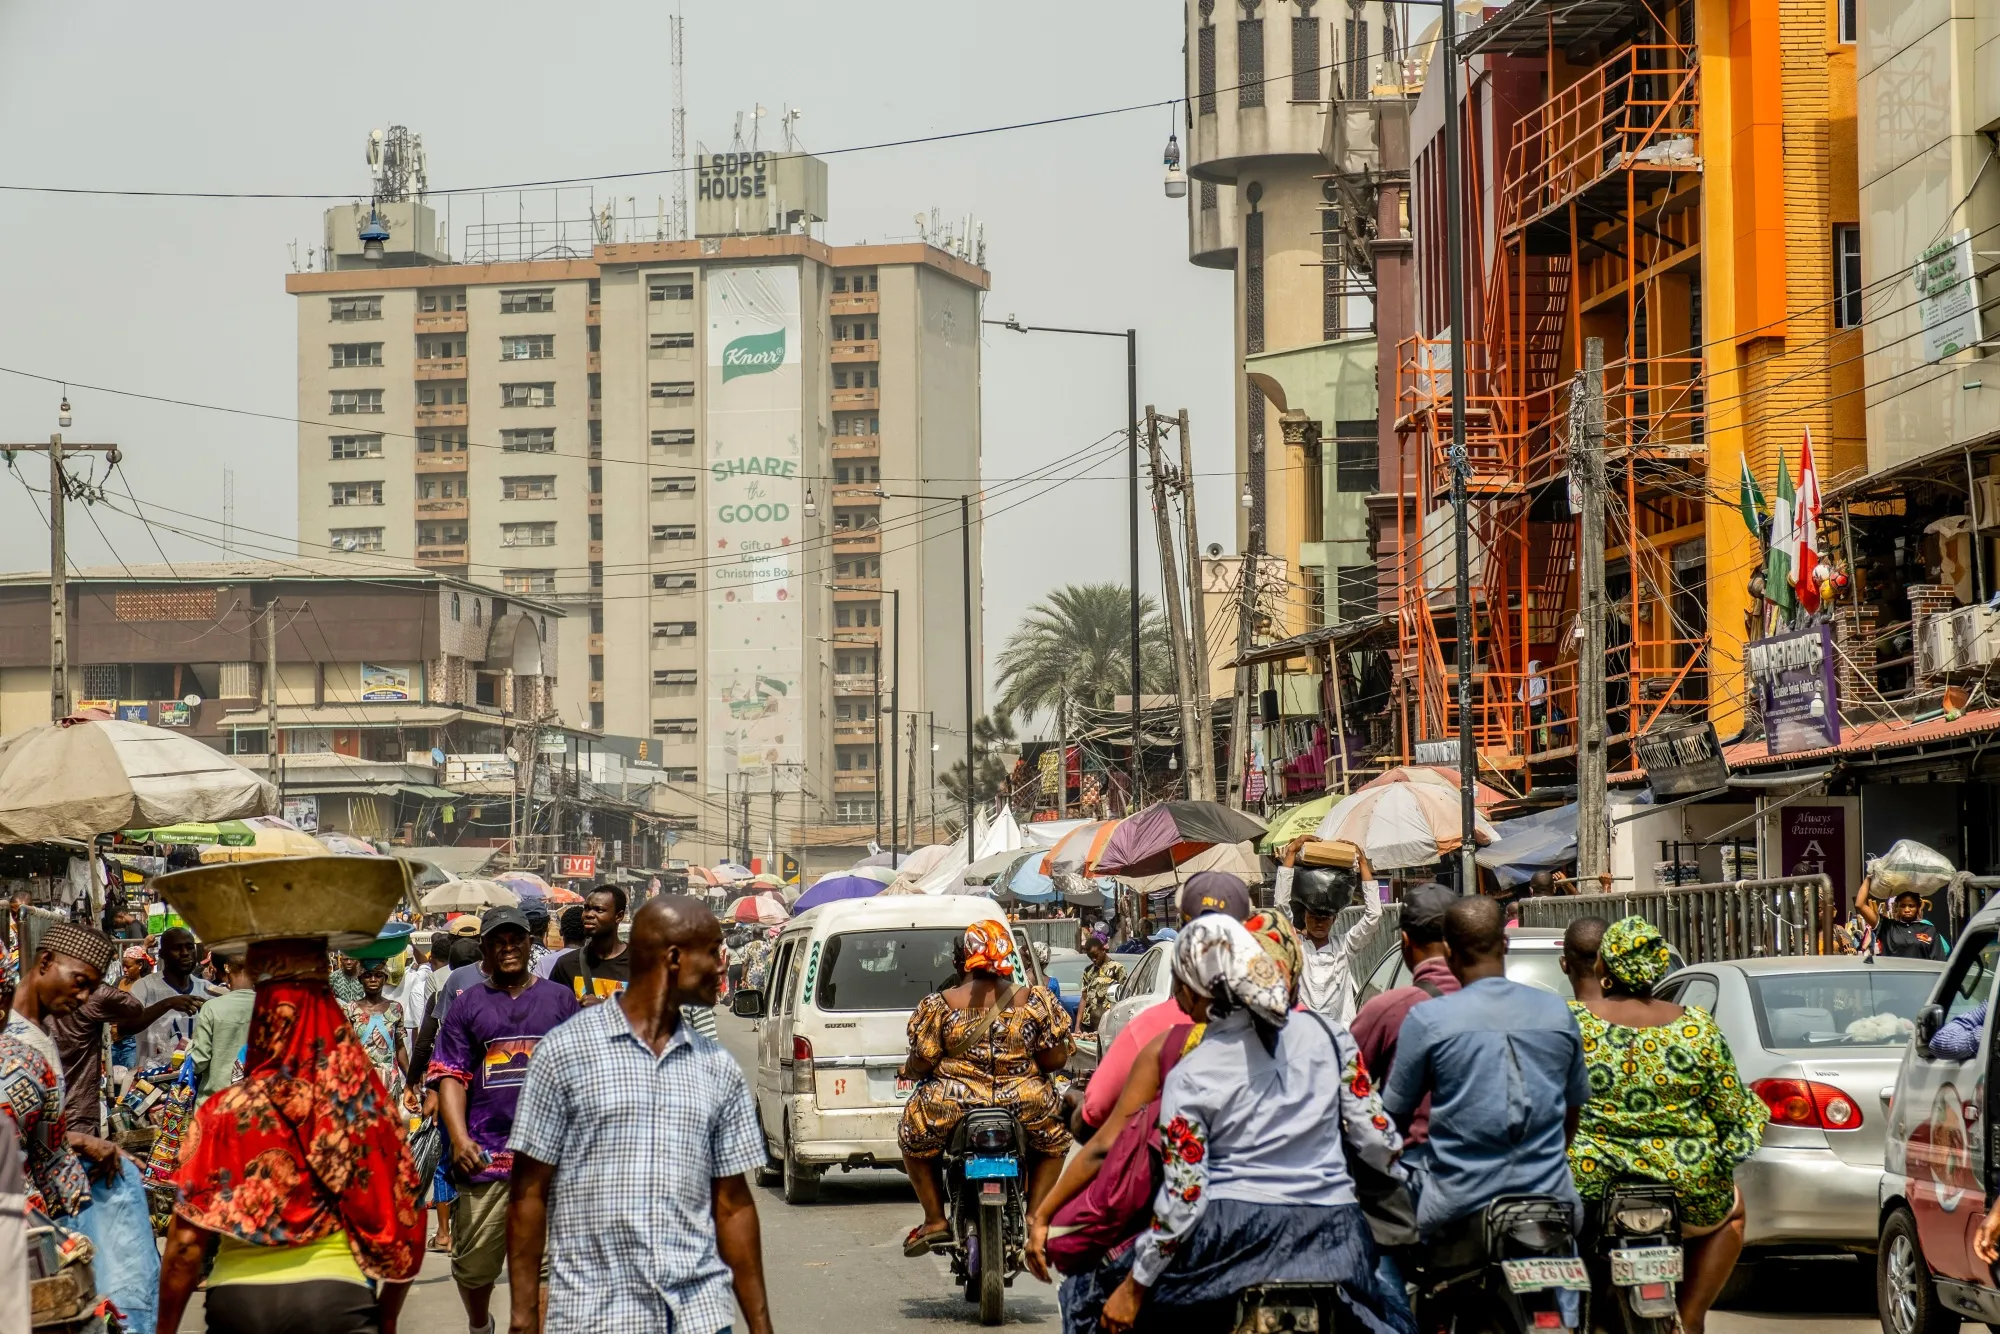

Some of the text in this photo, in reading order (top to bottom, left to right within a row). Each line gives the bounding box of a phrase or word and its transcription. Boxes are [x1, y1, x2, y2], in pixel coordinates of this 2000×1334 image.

[698, 151, 766, 177] LSDPC
[698, 175, 767, 200] HOUSE
[711, 456, 797, 482] SHARE
[743, 480, 767, 500] the
[718, 503, 790, 524] GOOD
[740, 540, 771, 551] Gift a
[741, 553, 769, 563] Knorr
[715, 567, 794, 579] Christmas Box
[1672, 732, 1711, 766] FABRICS
[1795, 812, 1831, 825] Always
[1791, 825, 1835, 835] Patronise
[563, 858, 591, 871] BYC
[1639, 1249, 1668, 1258] LAGOS
